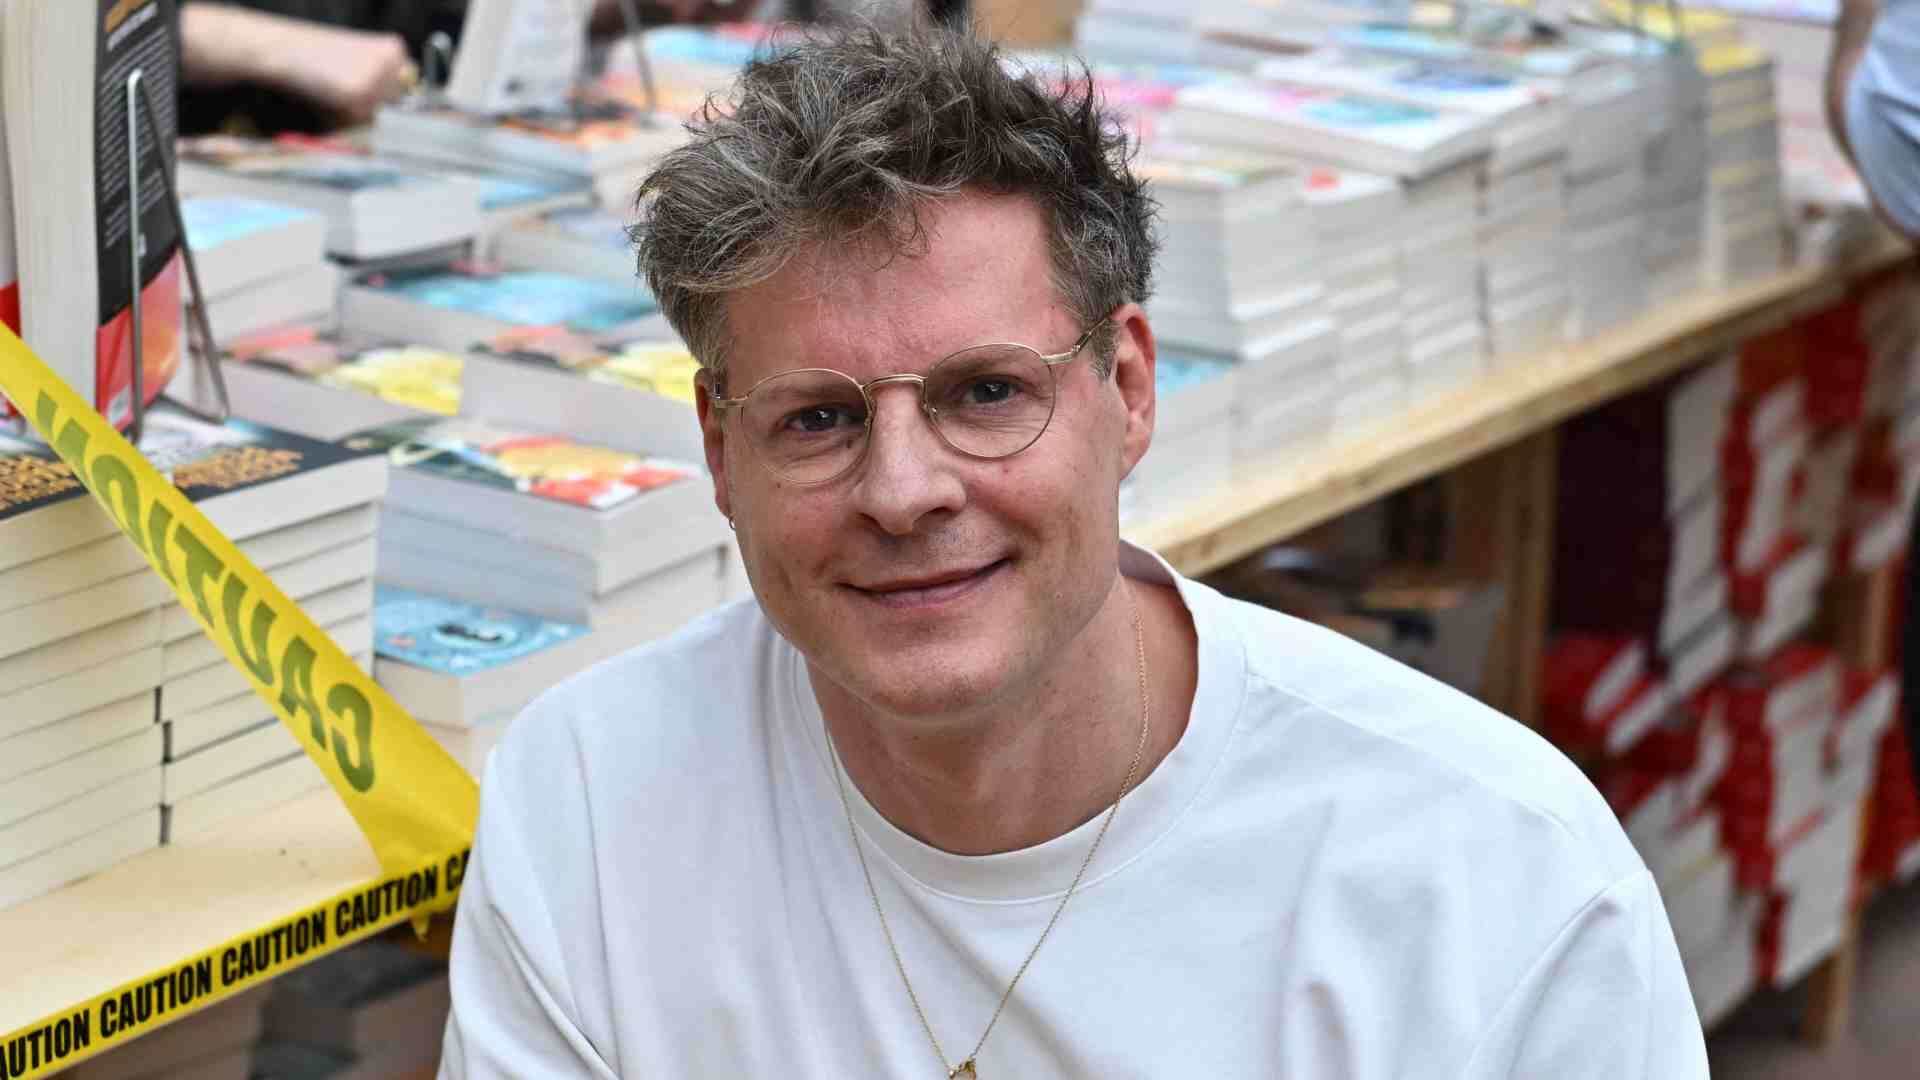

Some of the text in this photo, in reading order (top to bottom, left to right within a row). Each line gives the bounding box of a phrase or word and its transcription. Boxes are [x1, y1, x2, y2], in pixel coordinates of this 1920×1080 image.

[100, 956, 212, 1039] CAUTION
[221, 910, 326, 987] CAUTION
[335, 864, 438, 938] CAUTION
